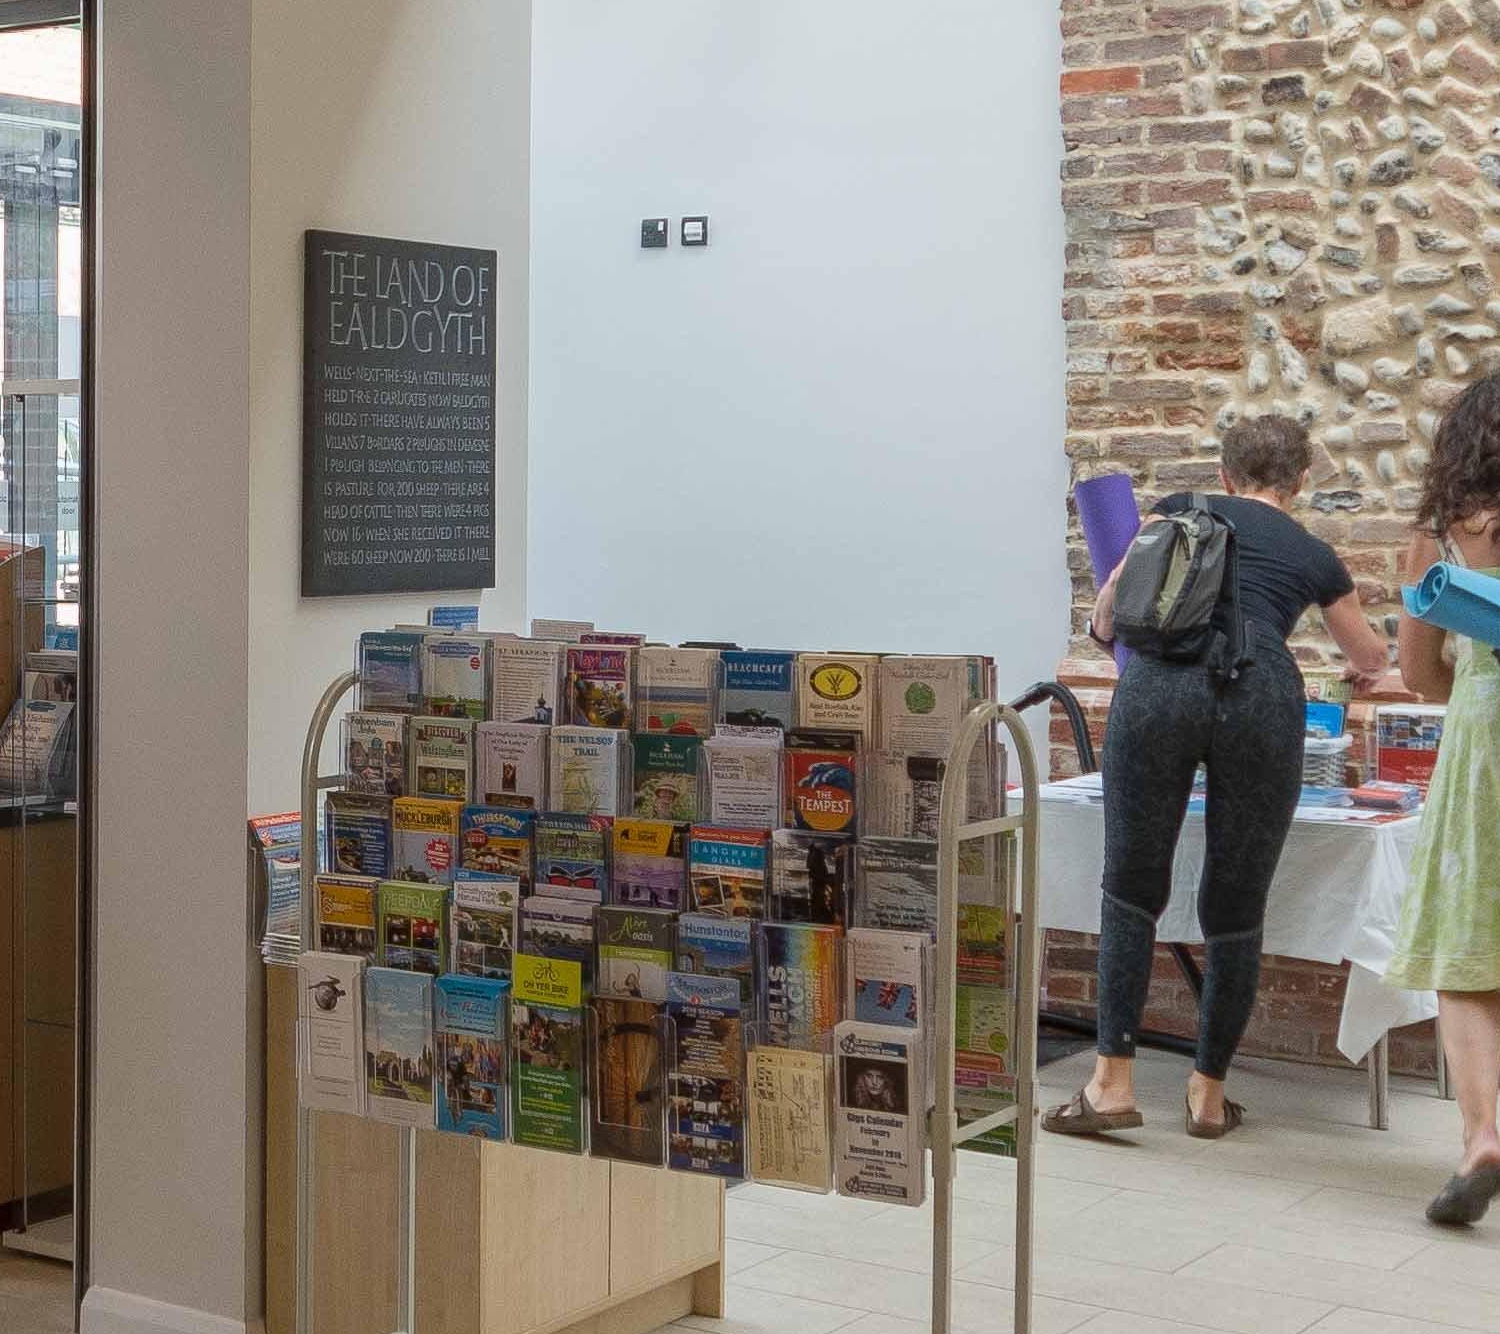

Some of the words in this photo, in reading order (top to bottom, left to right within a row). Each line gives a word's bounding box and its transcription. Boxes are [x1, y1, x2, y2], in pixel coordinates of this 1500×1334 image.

[321, 250, 367, 297] THE
[376, 255, 445, 307] LAND
[452, 265, 489, 307] OF
[329, 303, 490, 356] EALDGYTH
[470, 373, 490, 387] MAN
[323, 387, 348, 403] HELD
[429, 392, 451, 408] NOW
[324, 410, 357, 427] HOLDS
[370, 412, 400, 428] THERE
[401, 413, 425, 429] HAVE
[425, 414, 460, 430] ALWAYS
[462, 415, 484, 431] BEEN
[417, 458, 429, 474] TO
[323, 482, 332, 496] IS
[335, 481, 376, 497] PASTURE
[377, 481, 397, 497] FOR
[397, 480, 414, 497] 200
[415, 481, 440, 496] SHEEP
[442, 481, 468, 497] THERE
[467, 481, 484, 497] ARE
[323, 503, 348, 519] HEAD
[350, 504, 364, 519] OF
[395, 503, 419, 518] THEN
[323, 526, 349, 542] NOW
[351, 526, 361, 542] 16
[392, 525, 409, 541] SHE
[411, 525, 451, 541] RECEIVED
[453, 525, 463, 540] IT
[464, 525, 491, 540] THERE
[323, 549, 350, 565] WERE
[351, 549, 364, 565] 60
[389, 548, 415, 564] NOW
[414, 547, 431, 564] 200
[558, 735, 576, 744] THE
[578, 735, 614, 746] NELSON
[573, 747, 600, 757] TRAIL
[816, 790, 833, 799] THE
[798, 796, 851, 814] TEMPEST
[692, 842, 759, 858] LANGHAM
[523, 980, 534, 989] ON
[535, 982, 551, 992] YER
[551, 984, 568, 995] BIKE
